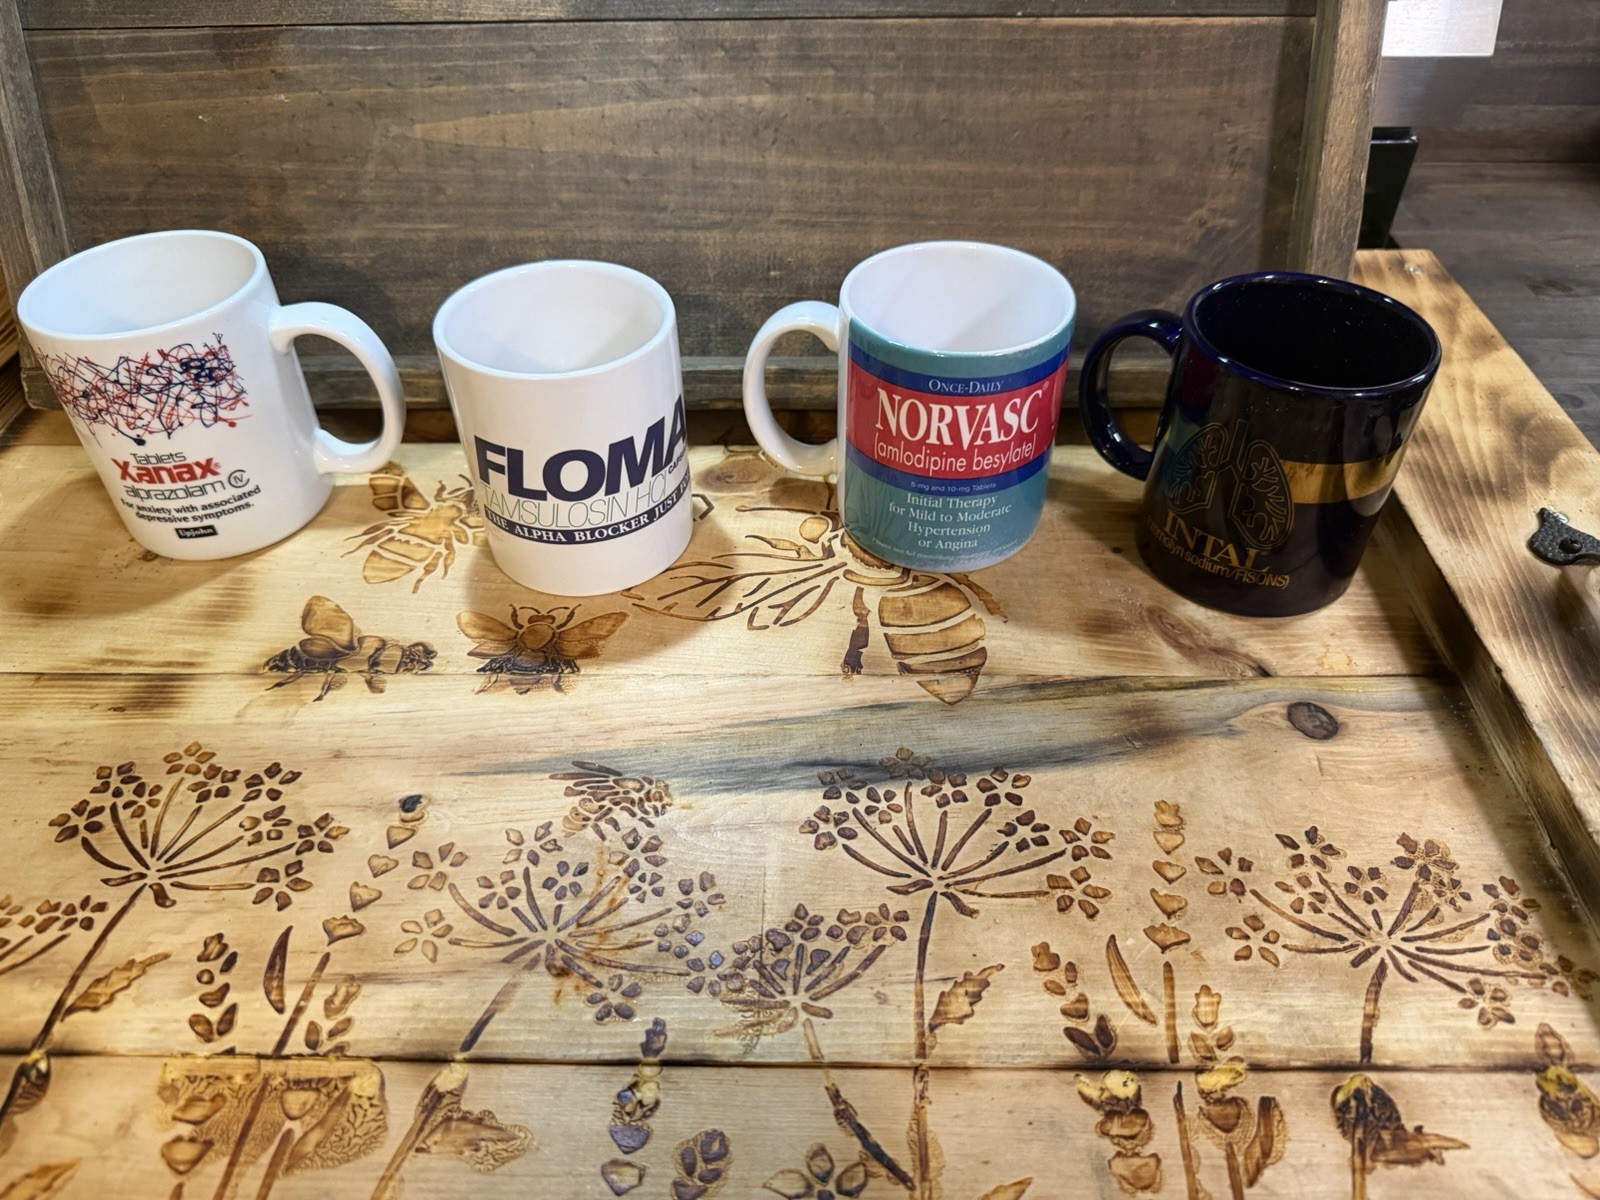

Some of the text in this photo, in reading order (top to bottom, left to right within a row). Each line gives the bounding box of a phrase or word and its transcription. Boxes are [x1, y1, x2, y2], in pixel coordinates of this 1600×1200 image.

[928, 379, 1003, 395] ONCE-DAILY
[875, 387, 1043, 451] NORVASC
[130, 452, 186, 465] Tablets
[874, 432, 1037, 477] (amlodipine besylate)
[123, 480, 226, 502] alprazolam
[973, 482, 996, 491] Tablets
[136, 504, 172, 515] anxiety
[174, 504, 199, 514] with
[201, 485, 262, 511] associated
[483, 484, 630, 528] TAMSULOSIN
[907, 493, 999, 510] Initial Therapy
[135, 503, 255, 523] depressive symptoms.
[485, 507, 509, 530] THE
[514, 526, 568, 542] ALPHA
[574, 515, 649, 542] BLOCKER
[653, 492, 678, 521] JUST
[889, 501, 1013, 523] for Mild to Moderate
[178, 528, 214, 538] Upjohn
[907, 521, 991, 538] Hypertension
[918, 539, 933, 549] or
[935, 539, 978, 552] Angina
[1163, 510, 1272, 572] INTAL
